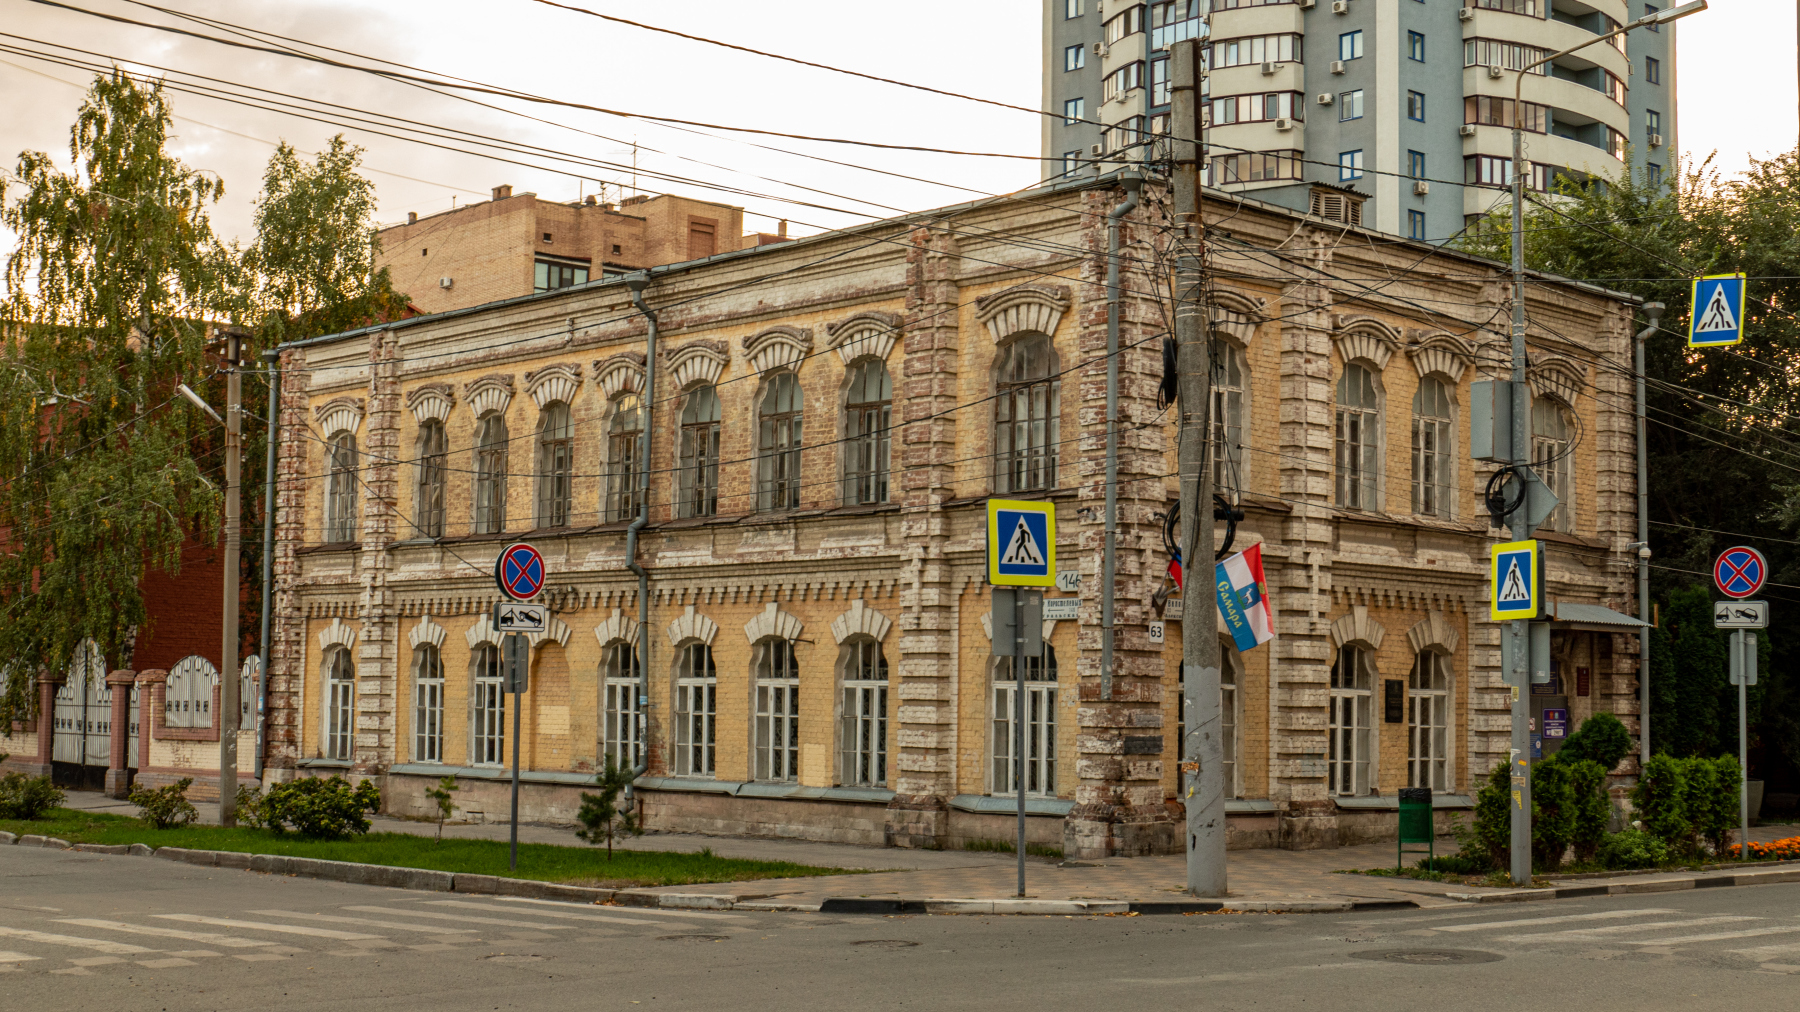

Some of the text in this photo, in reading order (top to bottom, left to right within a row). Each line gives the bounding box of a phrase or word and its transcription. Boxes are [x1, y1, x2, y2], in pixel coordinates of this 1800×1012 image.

[1062, 574, 1082, 588] 146
[1217, 581, 1242, 628] Самара
[1150, 626, 1162, 638] 63
